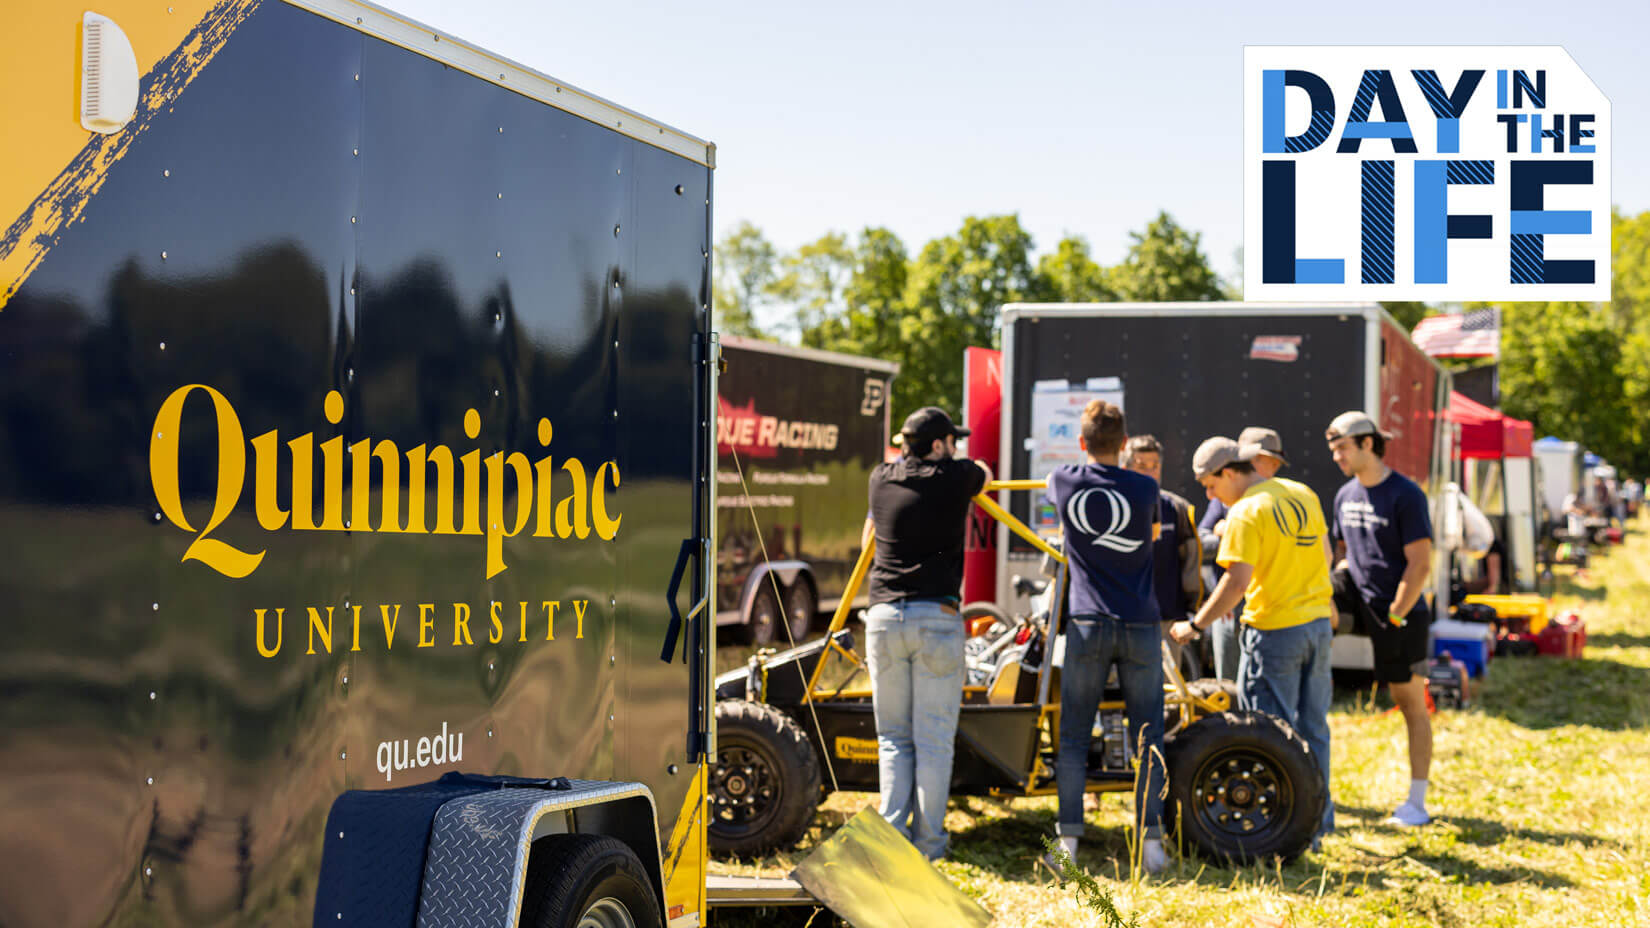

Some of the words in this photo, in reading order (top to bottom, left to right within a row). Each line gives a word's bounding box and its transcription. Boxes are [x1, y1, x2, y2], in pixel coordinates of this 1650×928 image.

[757, 416, 839, 451] RACING
[150, 384, 622, 579] Quinnipiac
[254, 600, 589, 658] UNIVERSITY
[376, 721, 464, 782] qu.edu
